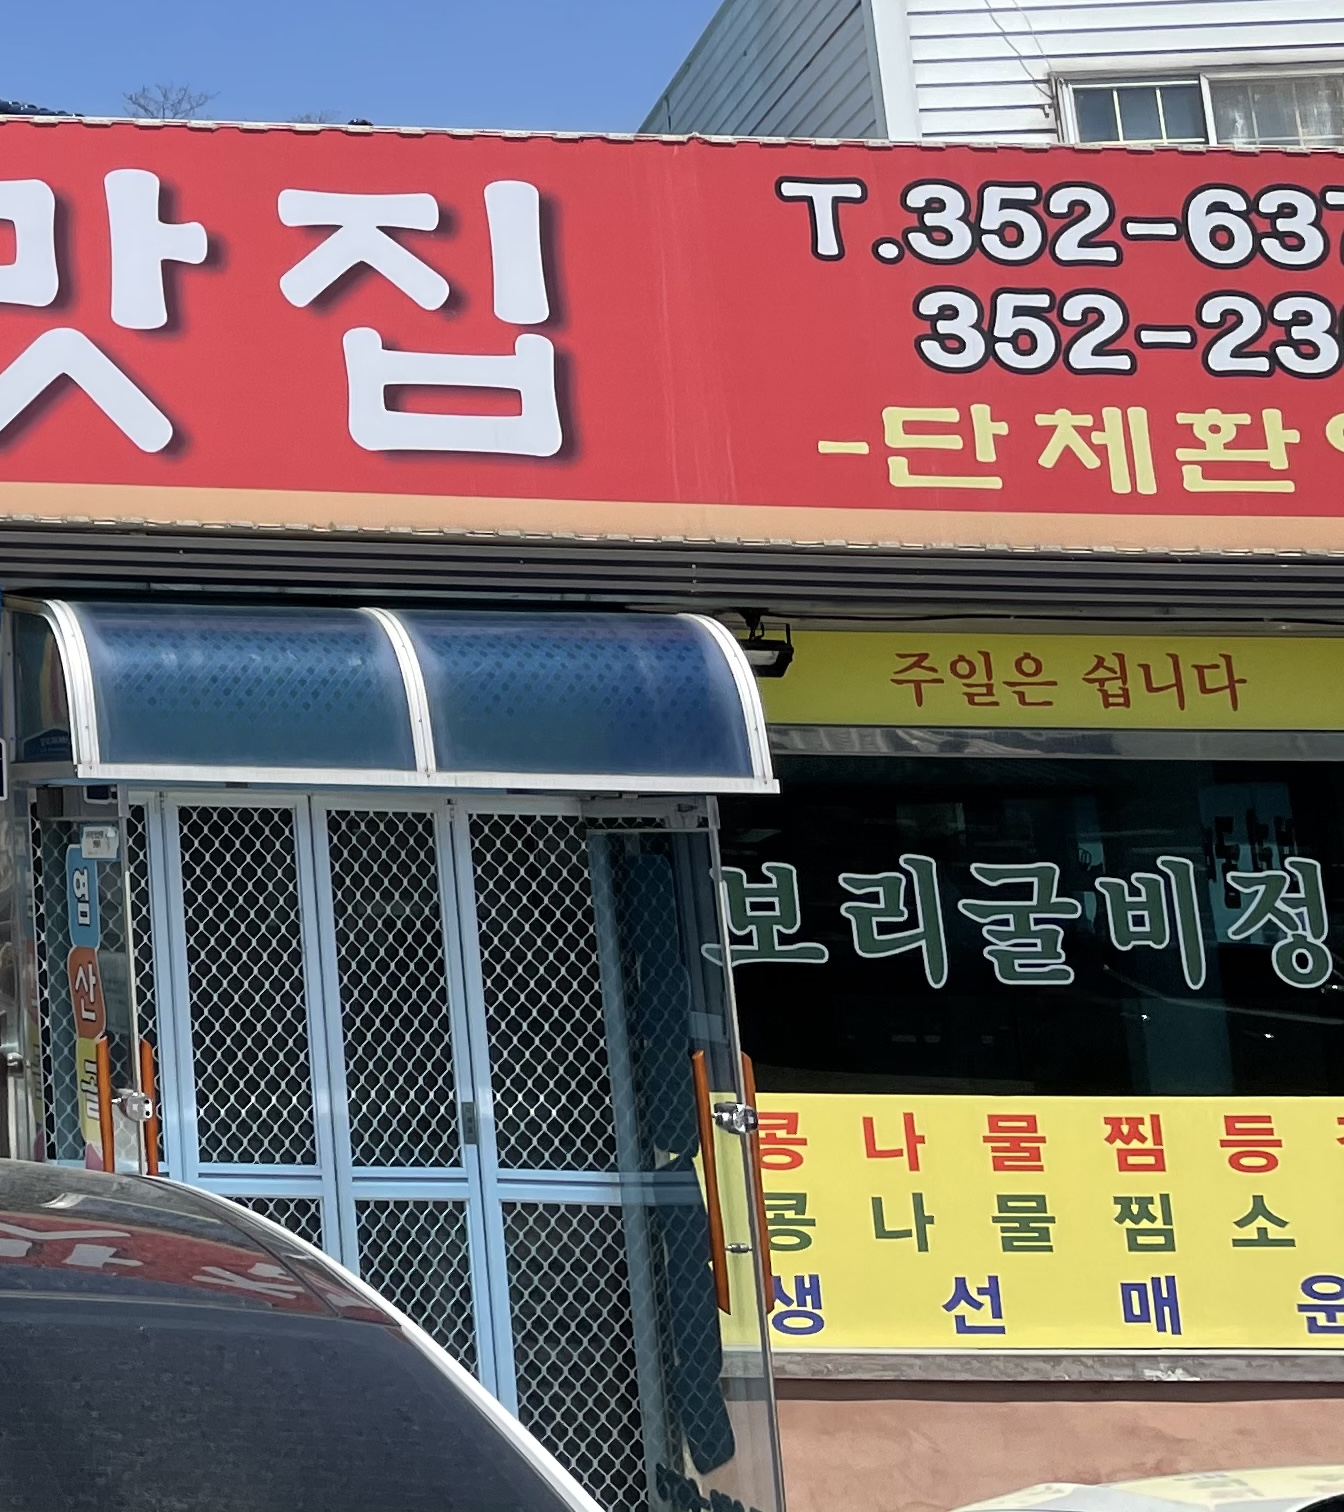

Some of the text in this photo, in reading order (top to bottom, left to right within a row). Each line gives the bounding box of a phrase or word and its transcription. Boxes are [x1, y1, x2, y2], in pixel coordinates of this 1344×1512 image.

[913, 284, 1344, 378] 352-23
[817, 402, 1344, 496] -단체환
[890, 650, 1248, 712] 주일은 쉽니다
